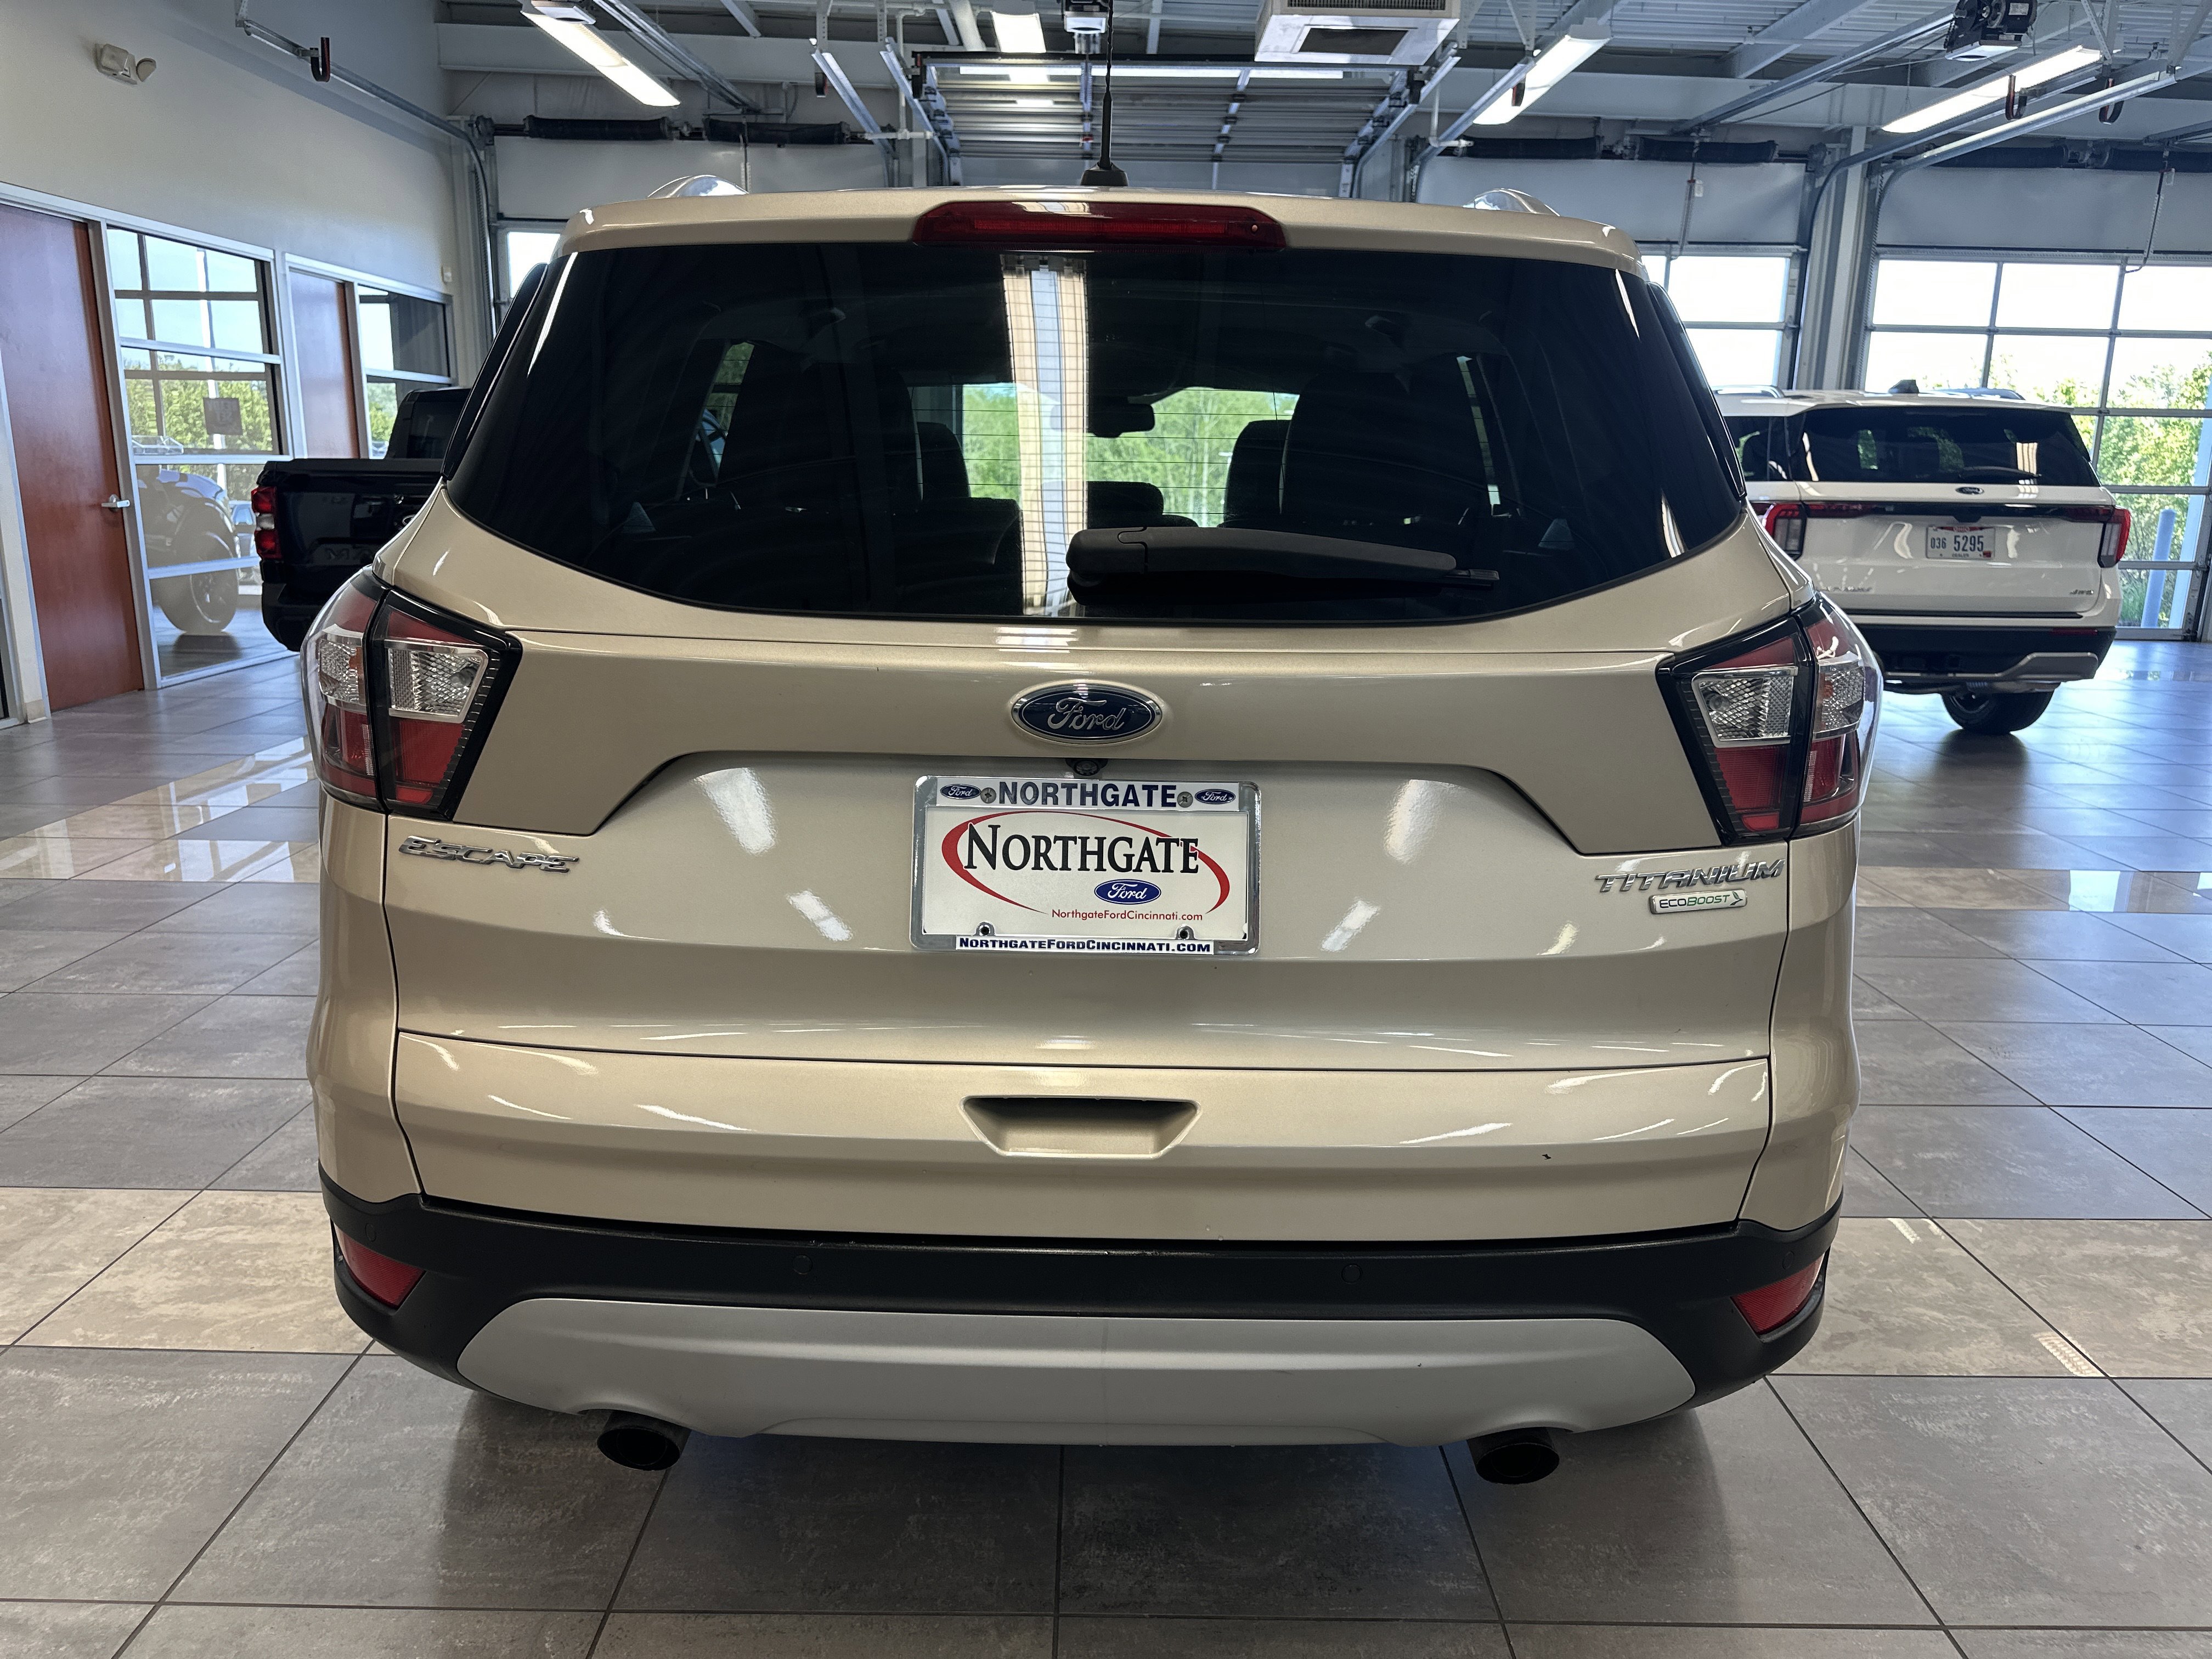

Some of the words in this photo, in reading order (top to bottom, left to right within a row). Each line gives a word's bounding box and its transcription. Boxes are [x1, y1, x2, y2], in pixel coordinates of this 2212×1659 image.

[1931, 537, 1946, 549] 036
[1954, 535, 1984, 551] 5295
[1047, 697, 1126, 730] Ford
[948, 786, 973, 797] Ford
[999, 781, 1177, 808] NORTHGATE
[1203, 791, 1227, 802] Ford
[399, 836, 579, 873] ESCAPE
[964, 823, 1199, 873] NORTHGATE
[1595, 858, 1786, 893] TITANIUM
[1107, 883, 1148, 900] Ford
[1659, 894, 1730, 909] ECOBOOST
[1052, 909, 1203, 921] NorthgateFordCincinnati.com
[959, 937, 1211, 952] NORTHGATEFORDCINCINNATI.COM
